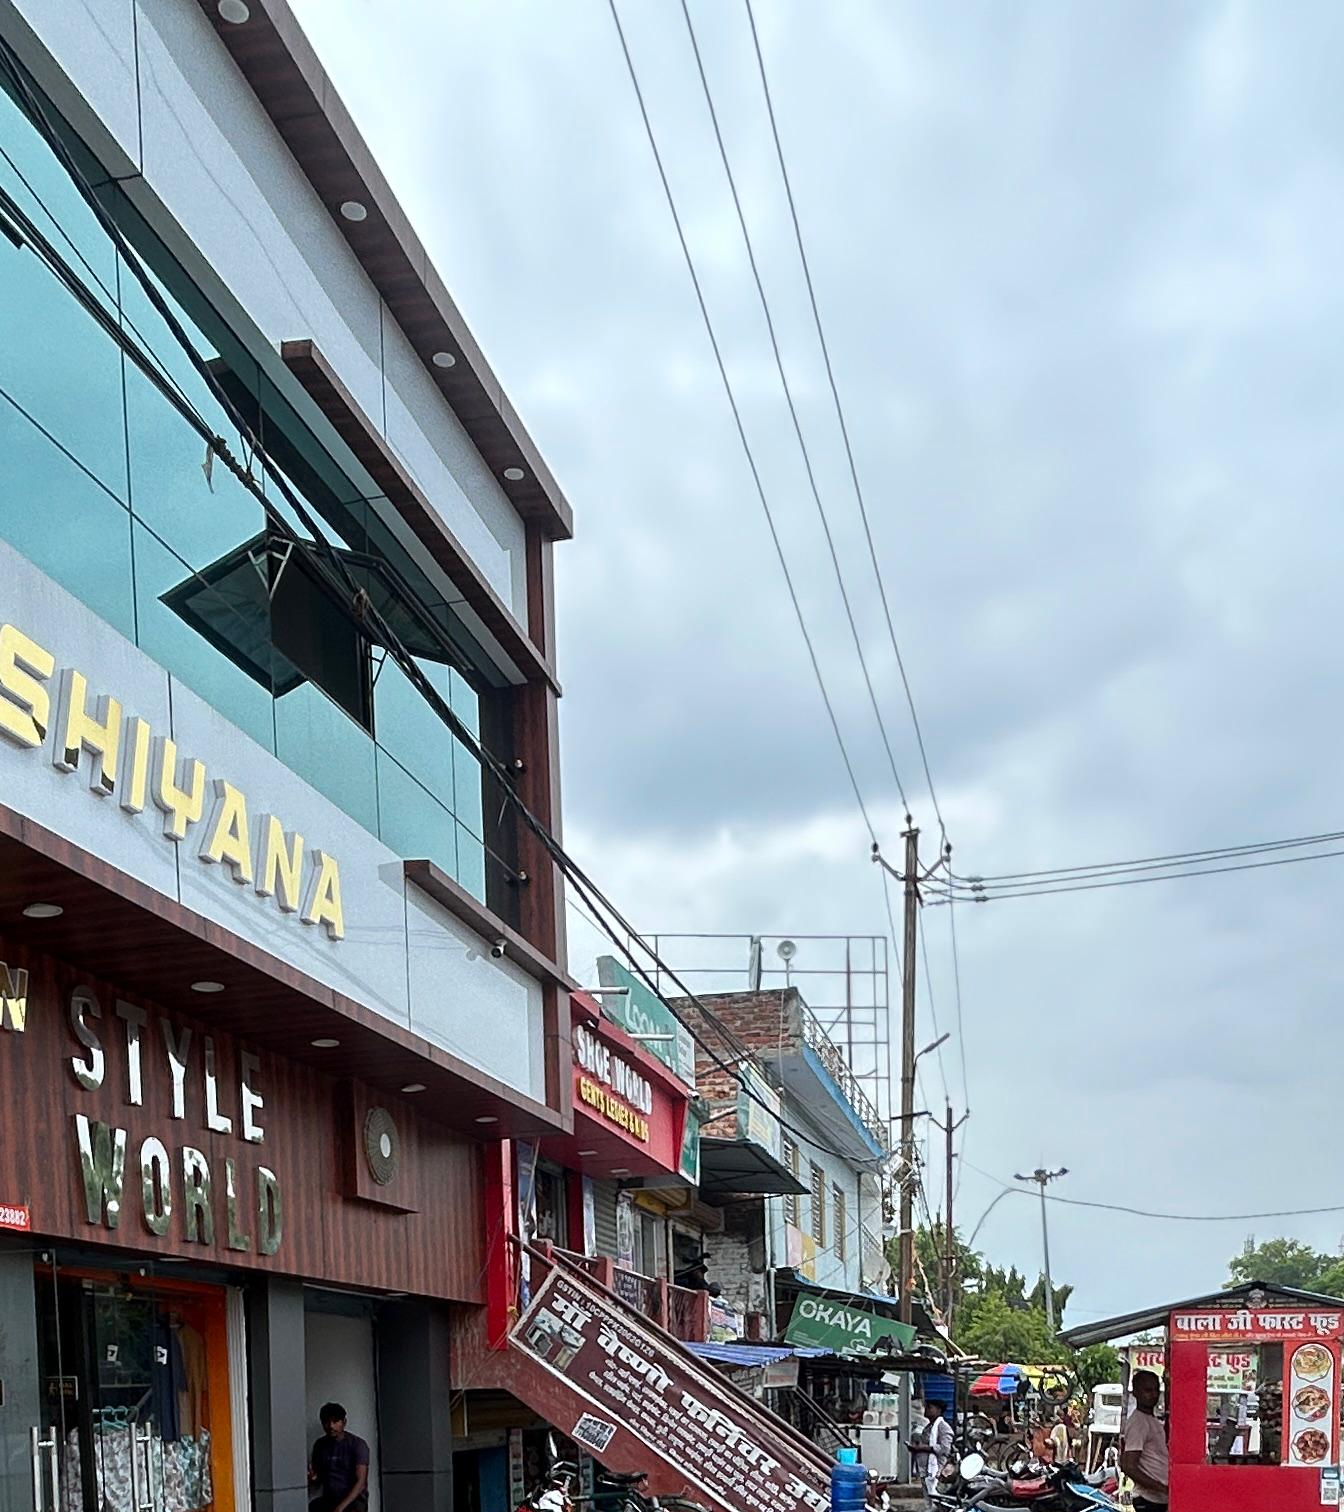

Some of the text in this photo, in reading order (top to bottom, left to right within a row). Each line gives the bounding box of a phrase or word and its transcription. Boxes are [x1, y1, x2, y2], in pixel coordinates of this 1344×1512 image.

[67, 984, 266, 1145] STYLE
[76, 1114, 284, 1255] WORLD
[799, 1300, 872, 1338] OKAYA
[1174, 1312, 1223, 1331] बाला
[1225, 1309, 1254, 1331] जी
[1256, 1313, 1306, 1331] फास्ट
